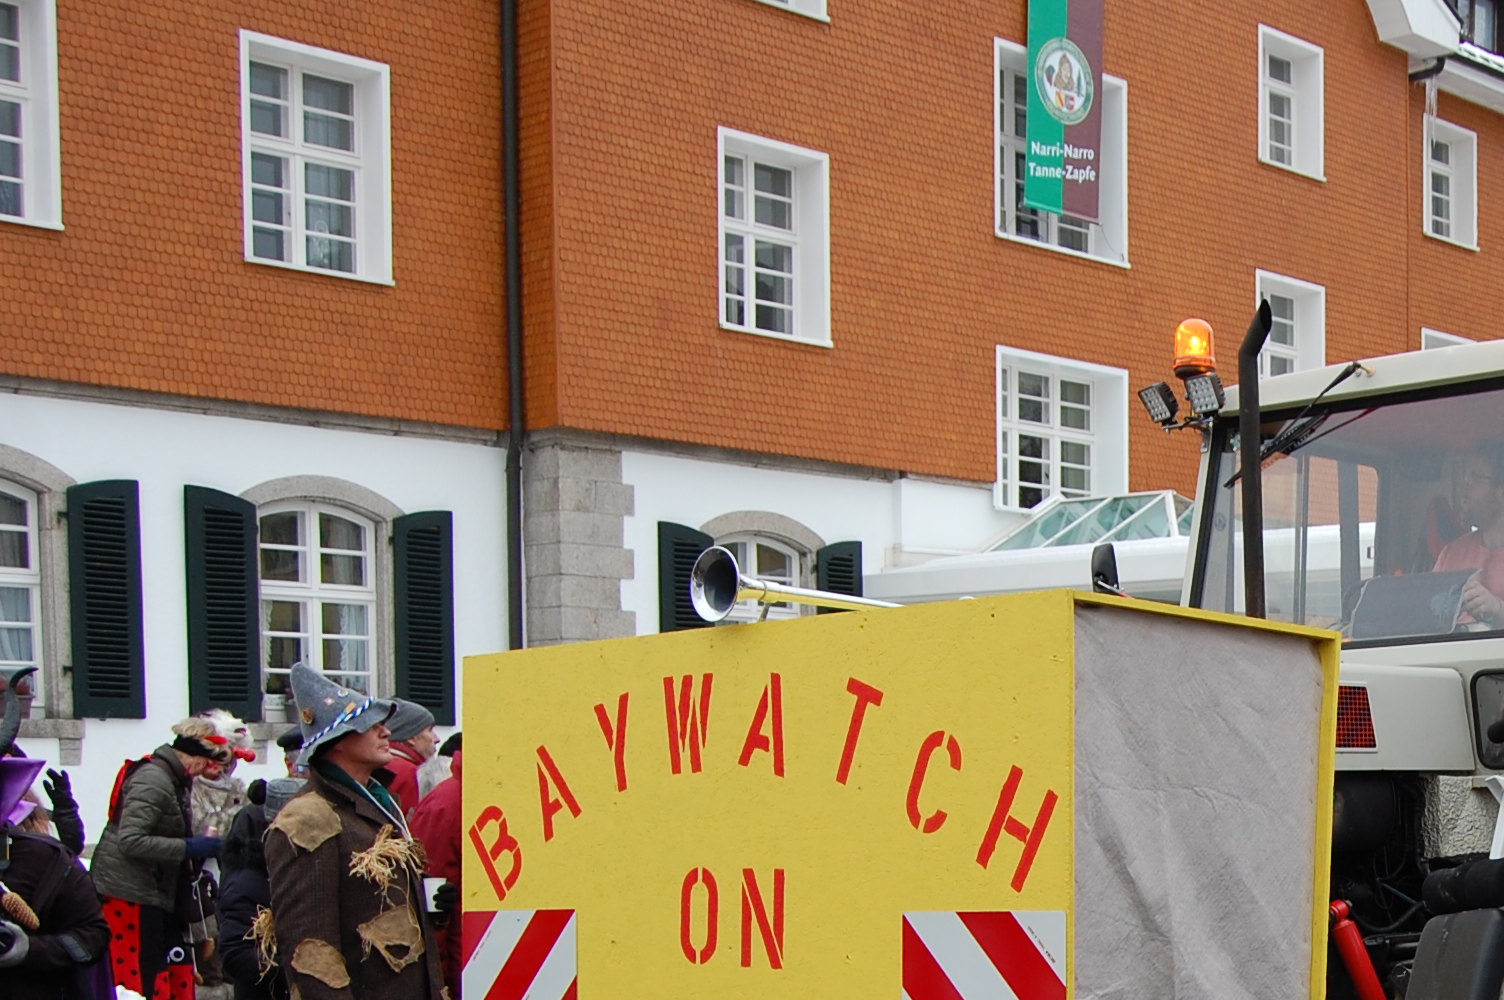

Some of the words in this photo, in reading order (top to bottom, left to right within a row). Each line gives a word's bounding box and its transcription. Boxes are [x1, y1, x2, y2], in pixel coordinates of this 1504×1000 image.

[1029, 162, 1096, 184] Tanne-Zapfe
[1031, 141, 1094, 160] Narri-Narro
[468, 672, 1058, 901] BAYWATCH
[680, 867, 785, 970] ON
